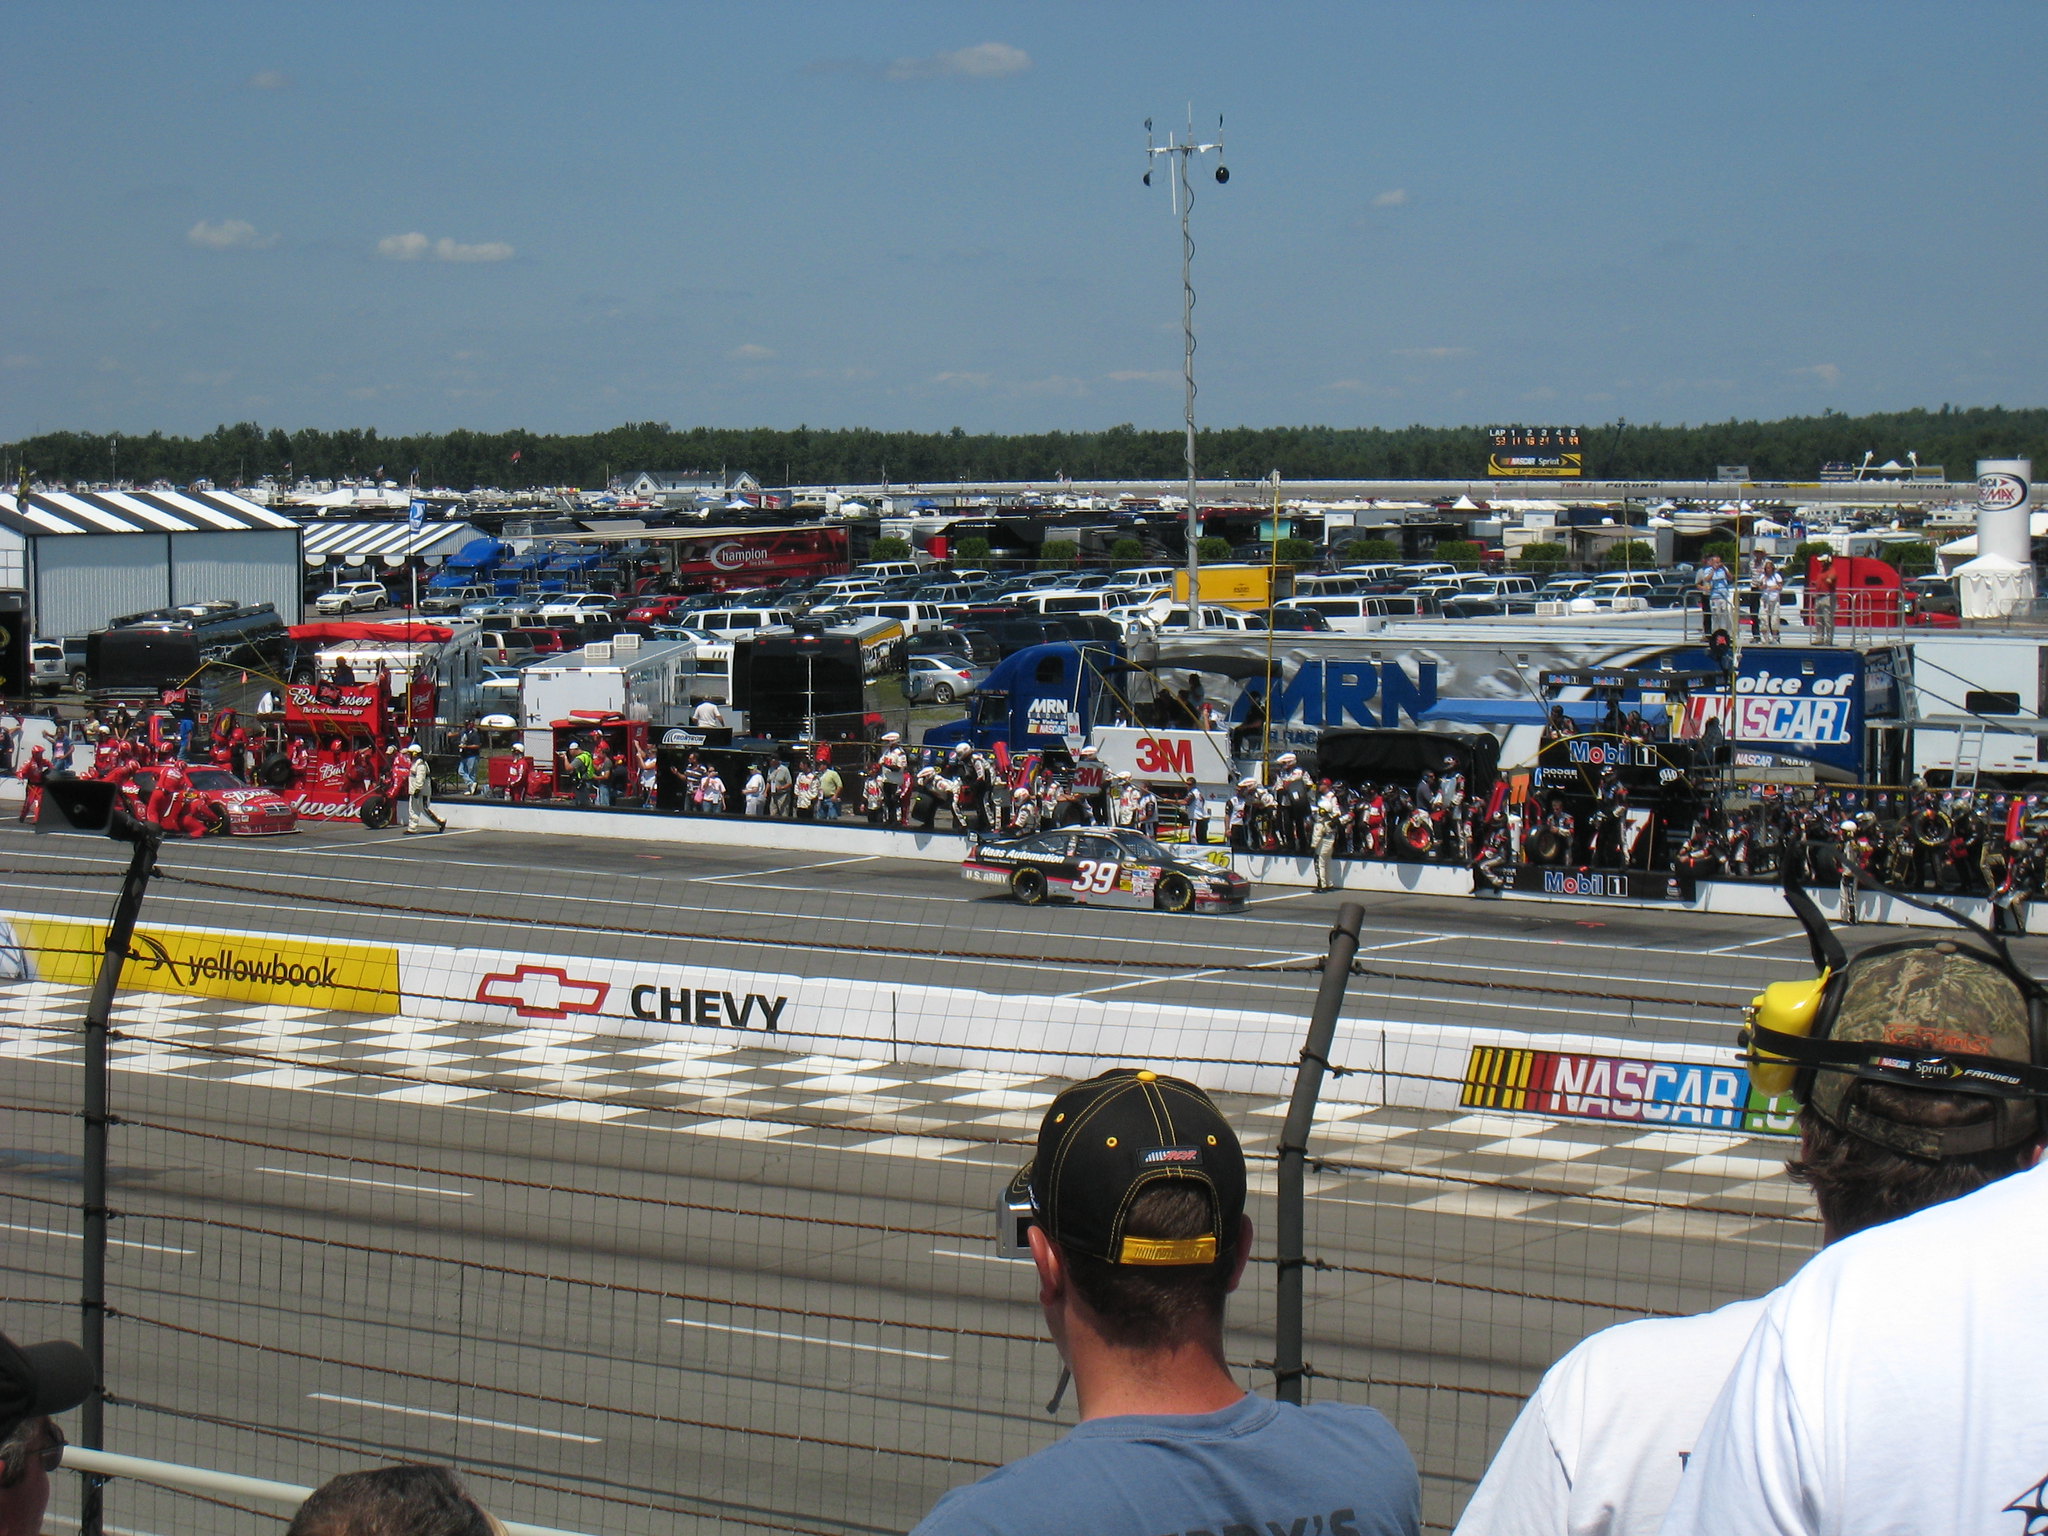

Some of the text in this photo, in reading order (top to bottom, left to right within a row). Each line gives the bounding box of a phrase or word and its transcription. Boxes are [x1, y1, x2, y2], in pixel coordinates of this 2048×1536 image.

[1490, 429, 1506, 437] LAP
[1527, 429, 1533, 437] 2
[1541, 429, 1548, 437] 3
[1570, 429, 1577, 437] 5
[1538, 458, 1560, 467] Sprint
[710, 542, 768, 570] Champion
[1716, 671, 1802, 694] oice
[1812, 674, 1854, 696] of
[1028, 699, 1068, 713] MRN
[1698, 698, 1838, 740] NASCAR
[1136, 738, 1194, 774] 3M
[1570, 741, 1632, 765] Mobil
[1735, 753, 1774, 766] NASCAR
[1073, 767, 1104, 787] 3M
[980, 846, 1006, 858] Haas
[1006, 849, 1066, 864] Automation
[1207, 851, 1231, 868] 16
[966, 870, 1009, 884] U.S. ARMY
[1072, 860, 1118, 894] 39
[1544, 871, 1604, 895] Mobil
[189, 950, 338, 988] yellowbook
[631, 984, 788, 1032] CHEVY
[1881, 1057, 2022, 1085] NASCAR Sprint FANVIEW
[1549, 1057, 1740, 1126] NASCAR
